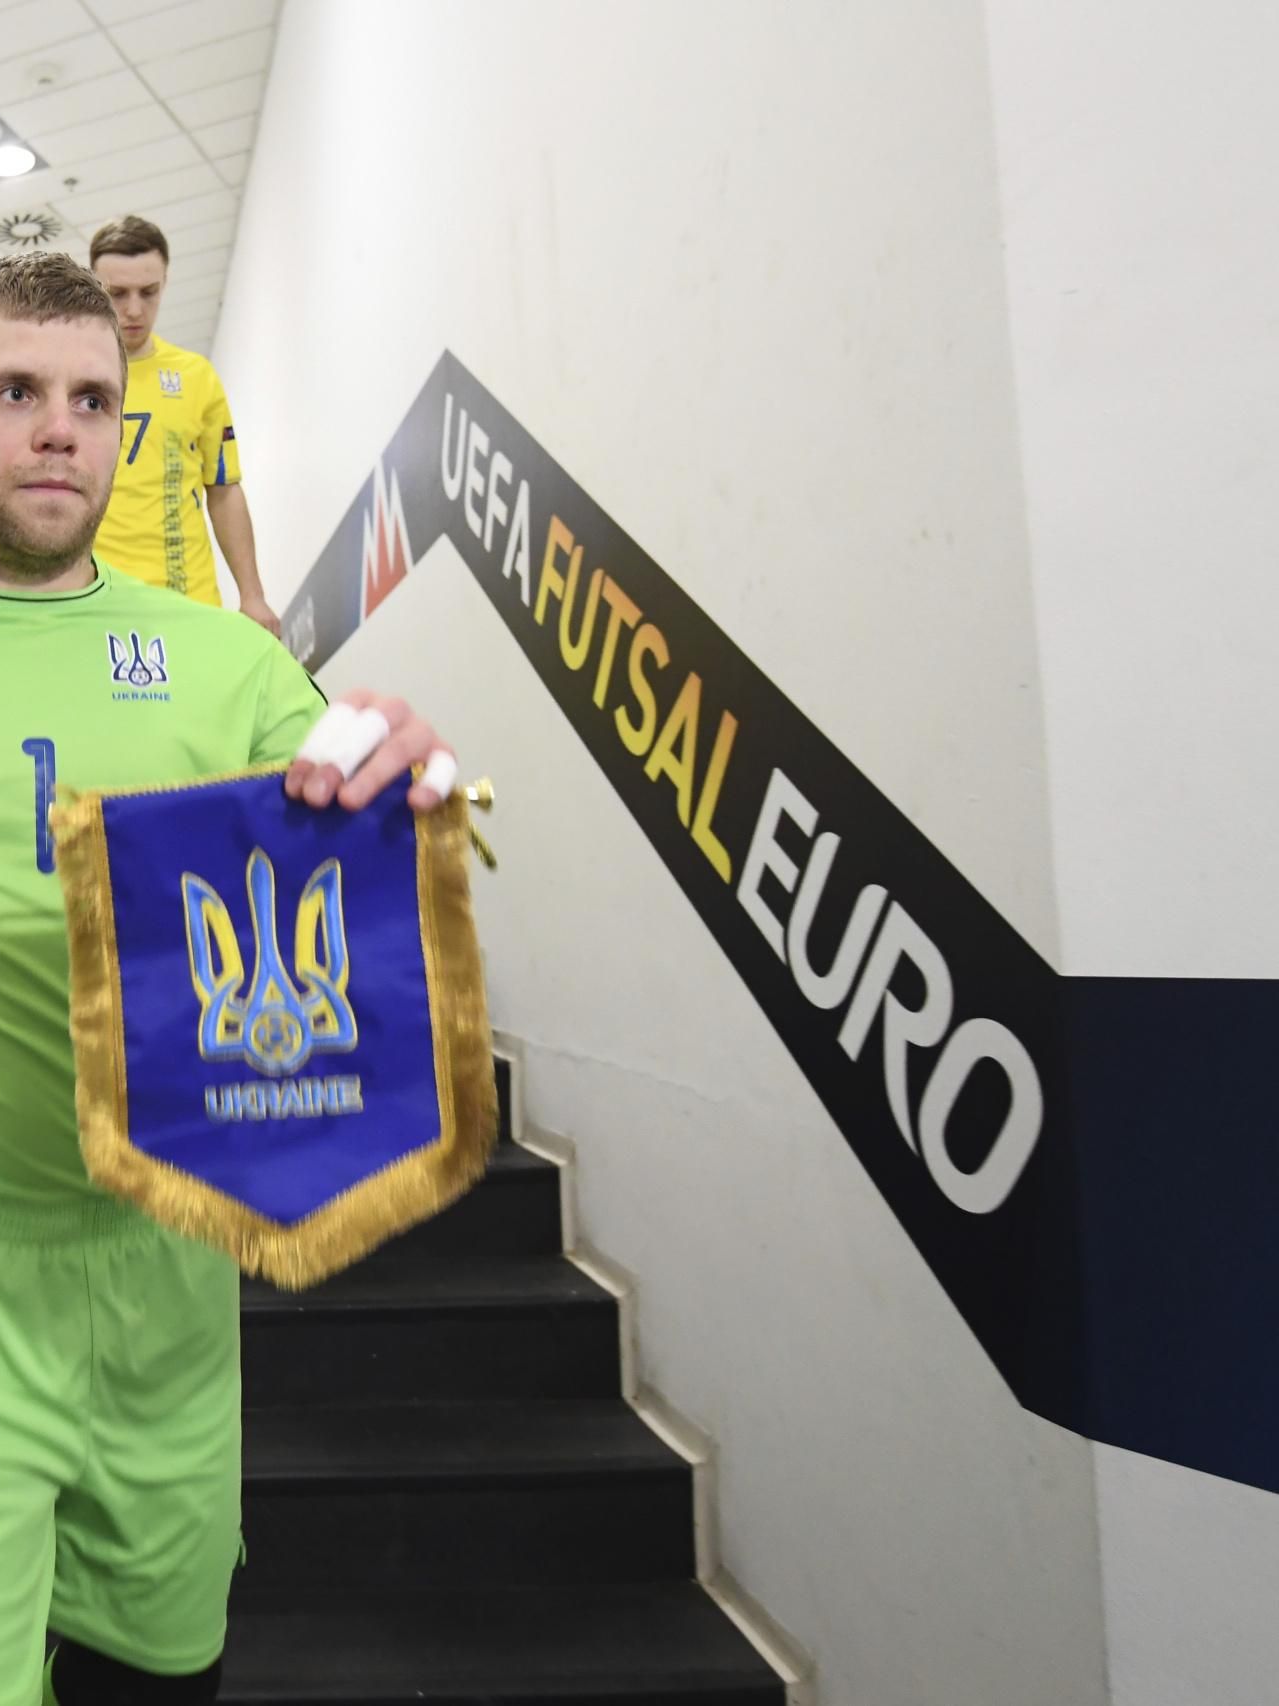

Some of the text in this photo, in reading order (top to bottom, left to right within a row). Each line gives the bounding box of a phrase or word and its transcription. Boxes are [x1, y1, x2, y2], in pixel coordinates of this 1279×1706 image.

[122, 412, 153, 465] 7
[112, 690, 172, 702] UKRAINE
[21, 736, 56, 875] 1
[440, 393, 1045, 1215] UEFA FUTSAL EURO
[204, 1074, 365, 1123] UKRAINE
